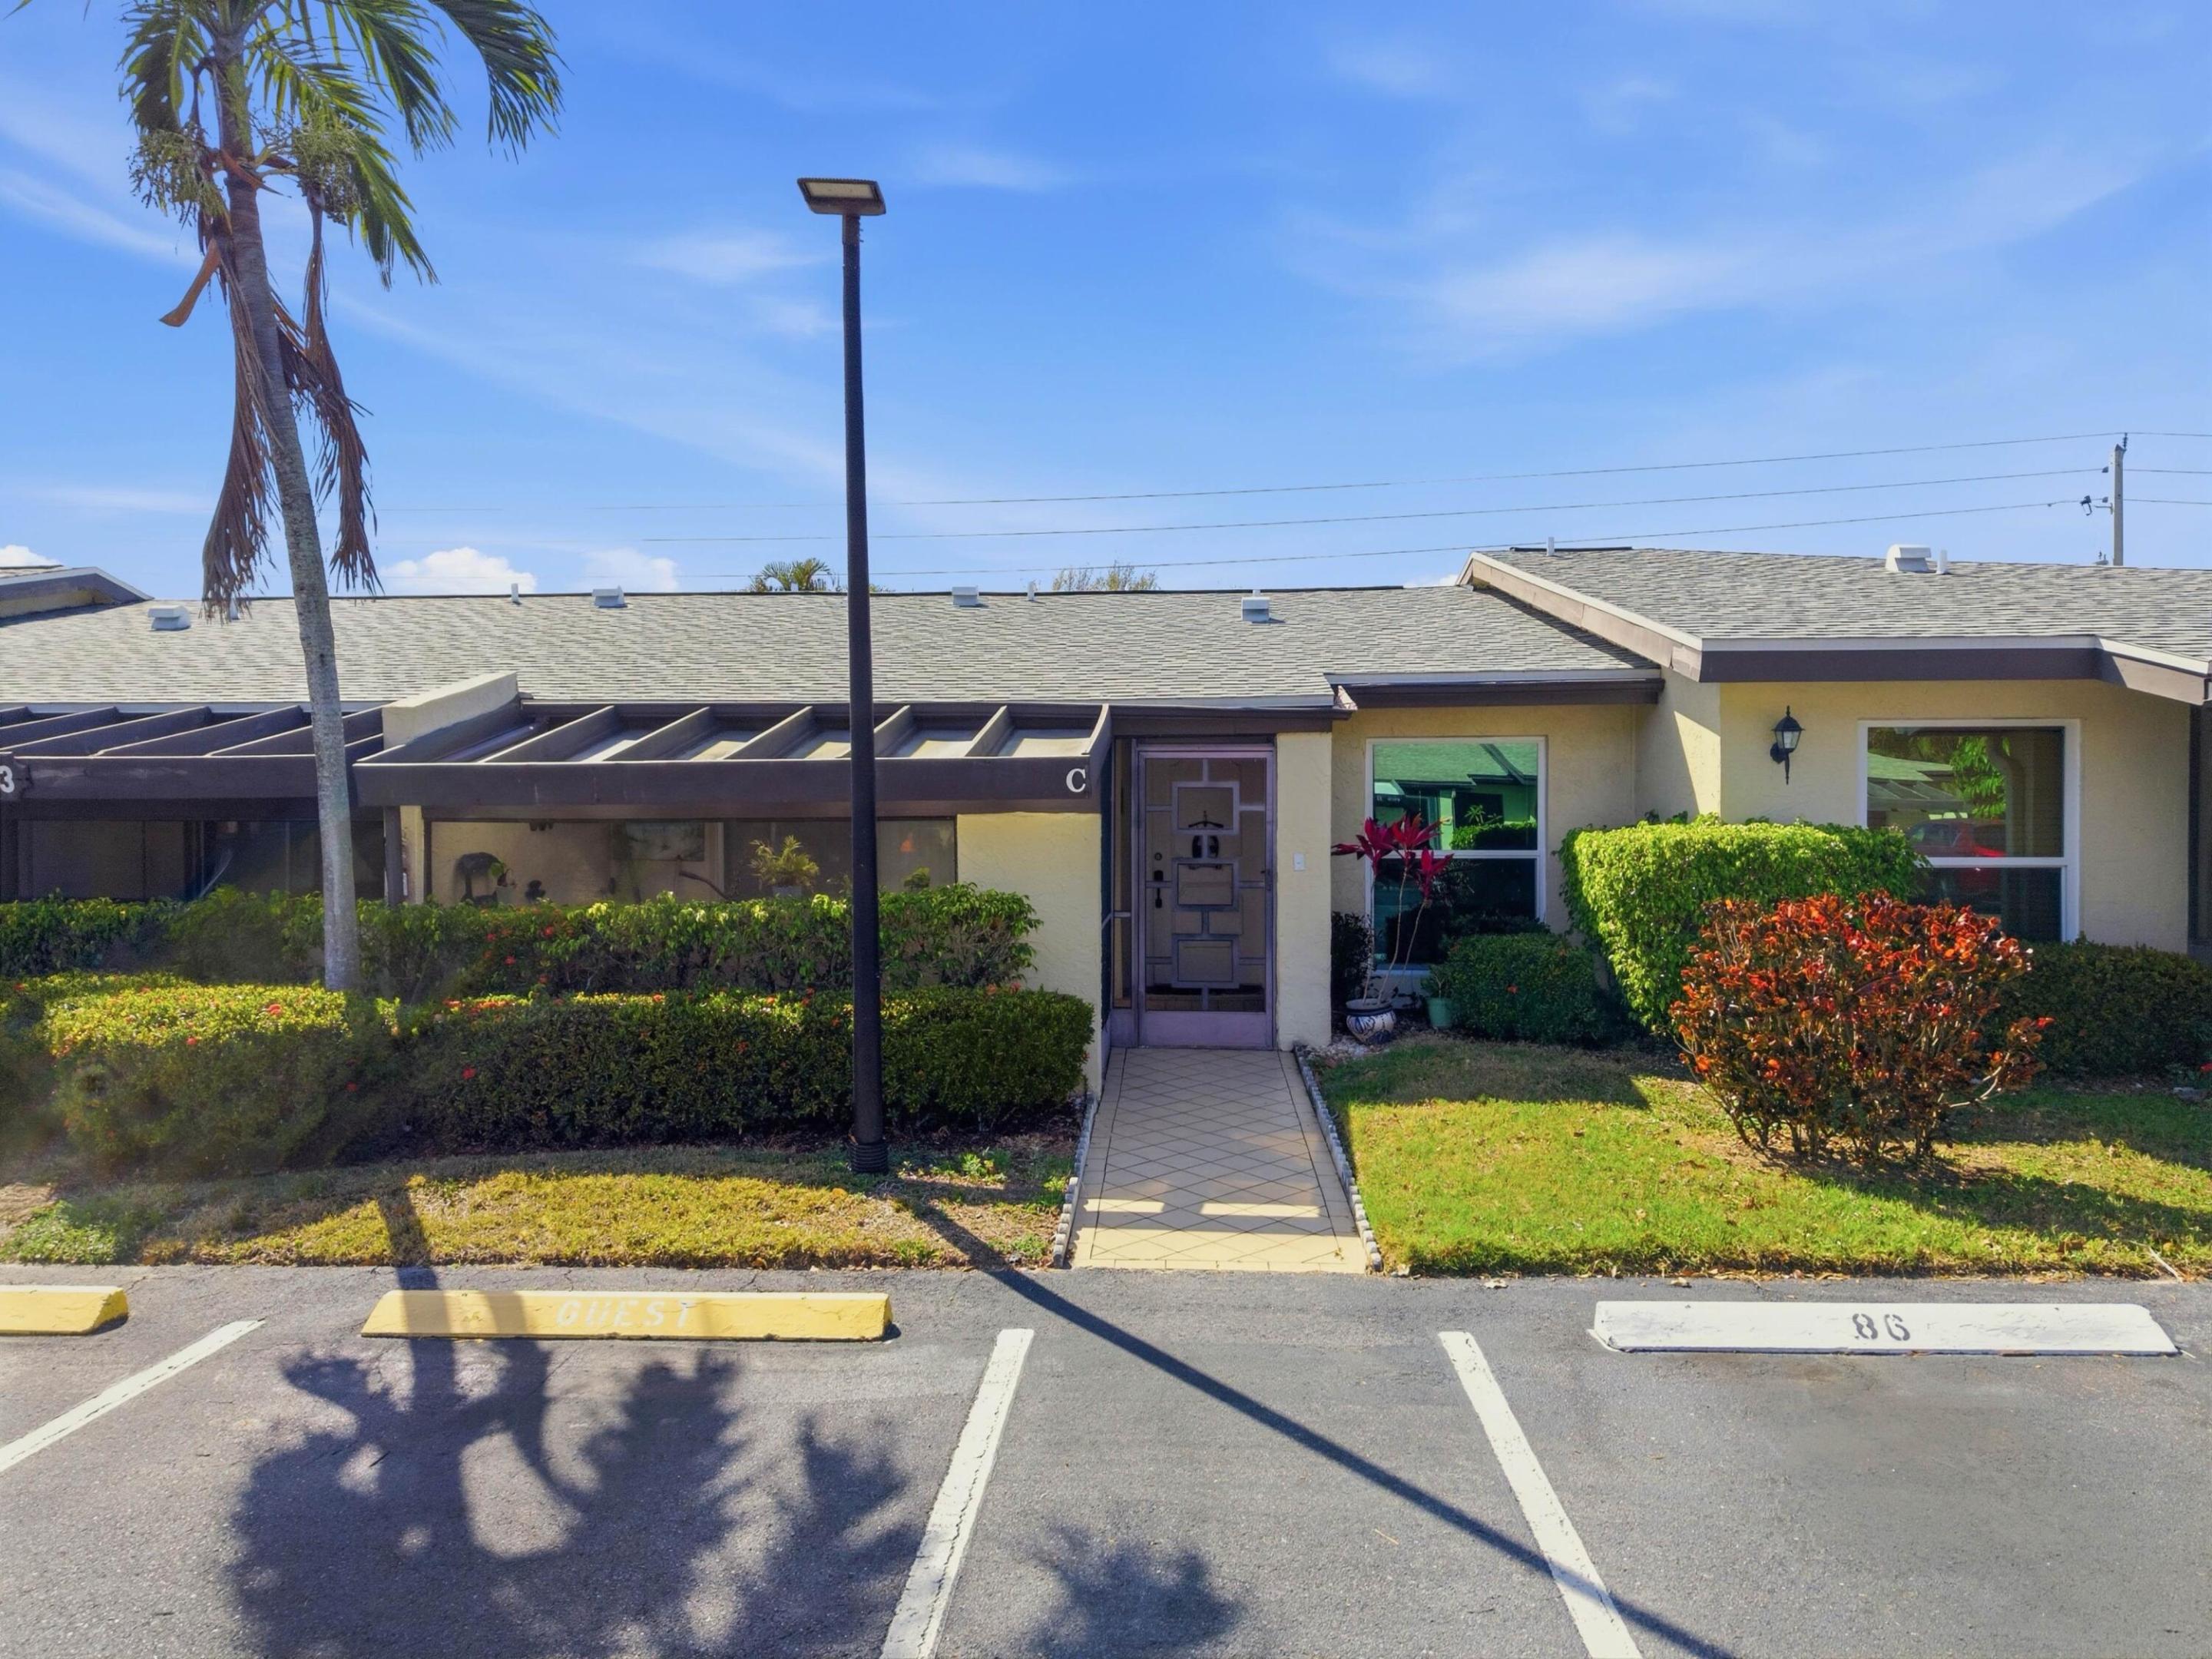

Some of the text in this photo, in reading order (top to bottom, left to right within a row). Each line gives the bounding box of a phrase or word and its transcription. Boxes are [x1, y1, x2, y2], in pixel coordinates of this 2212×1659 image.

[0, 765, 15, 793] 3
[1066, 768, 1086, 793] C
[556, 1299, 696, 1330] GUEST
[1852, 1313, 1911, 1342] 86
